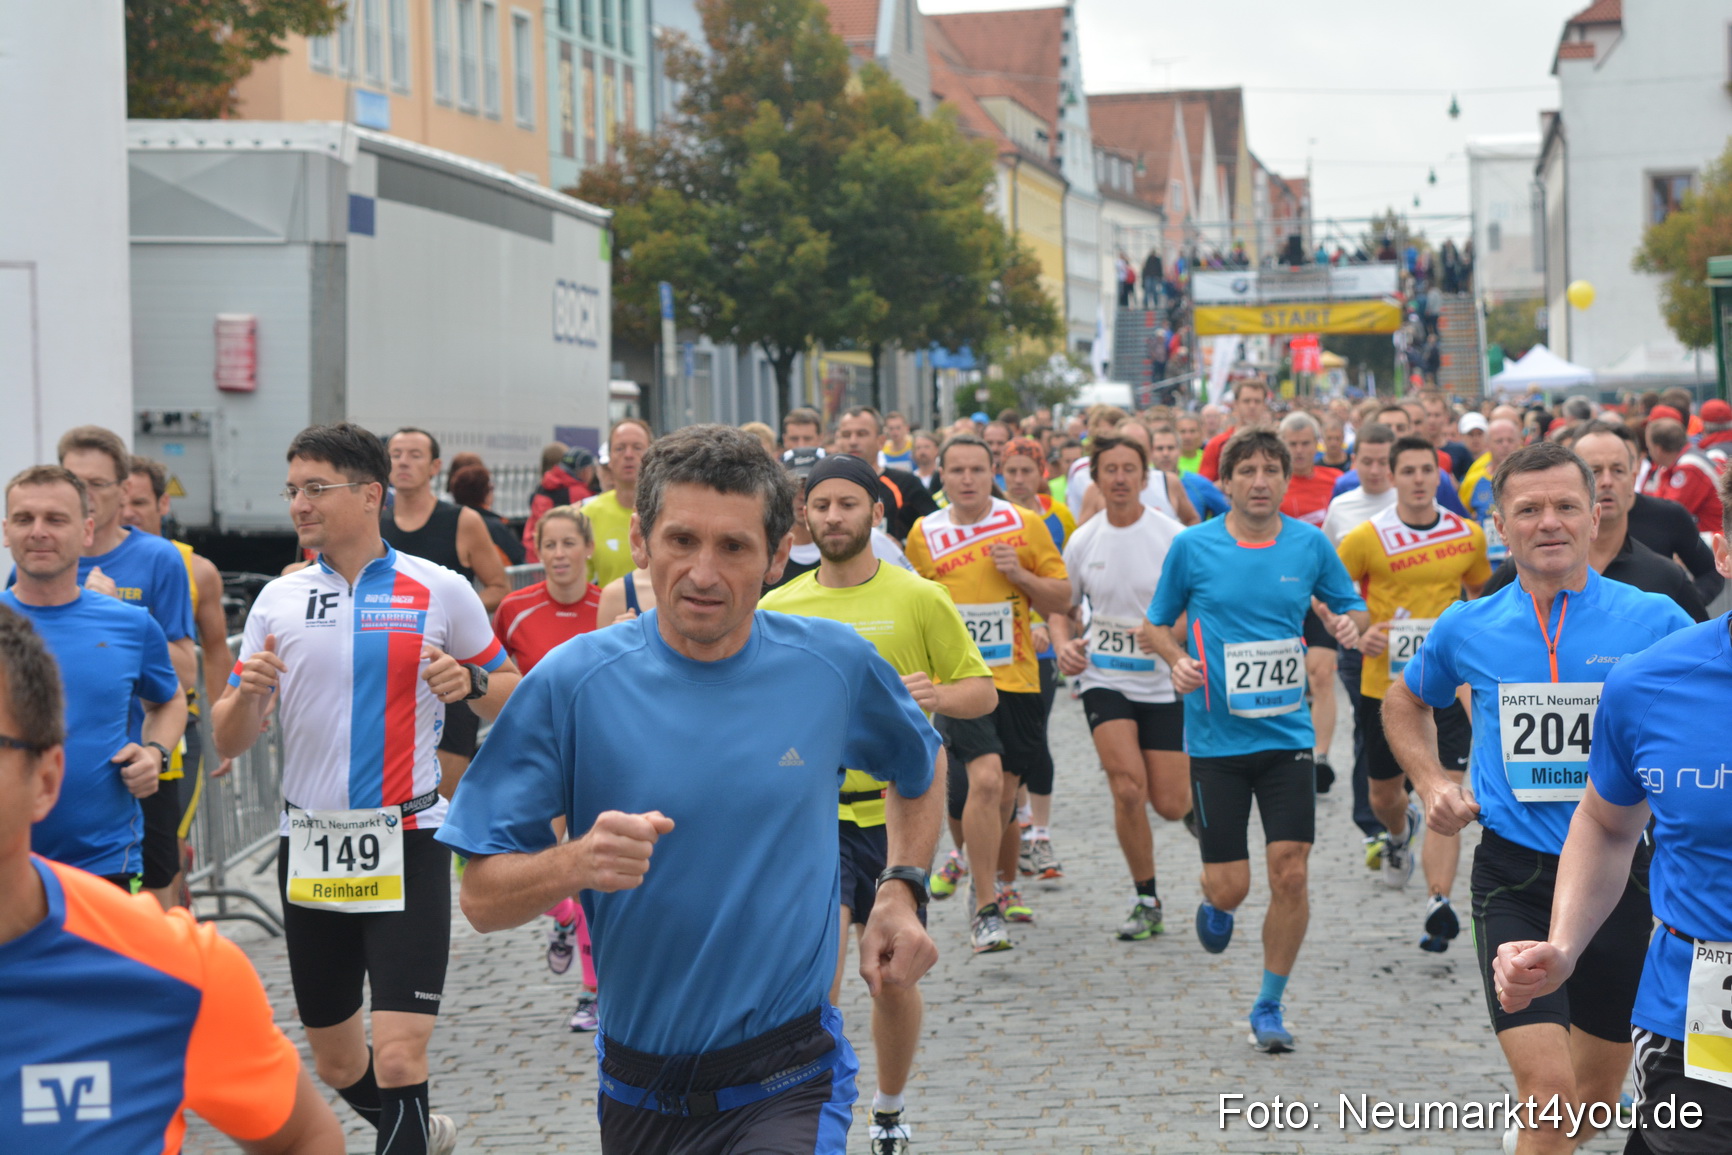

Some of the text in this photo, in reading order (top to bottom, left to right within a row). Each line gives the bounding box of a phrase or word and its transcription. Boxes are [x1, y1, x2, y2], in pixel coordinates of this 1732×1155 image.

[1261, 308, 1332, 328] START
[936, 551, 976, 577] MAX
[1390, 542, 1476, 572] MAX BÖGL
[305, 589, 340, 619] iF
[361, 613, 418, 623] LA CARRERA
[1235, 658, 1299, 689] 2742
[1255, 695, 1284, 706] Klaus
[1502, 695, 1544, 706] PARTL
[292, 818, 381, 829] PARTL Neumarkt
[314, 834, 380, 872] 149
[312, 882, 379, 898] Reinhard
